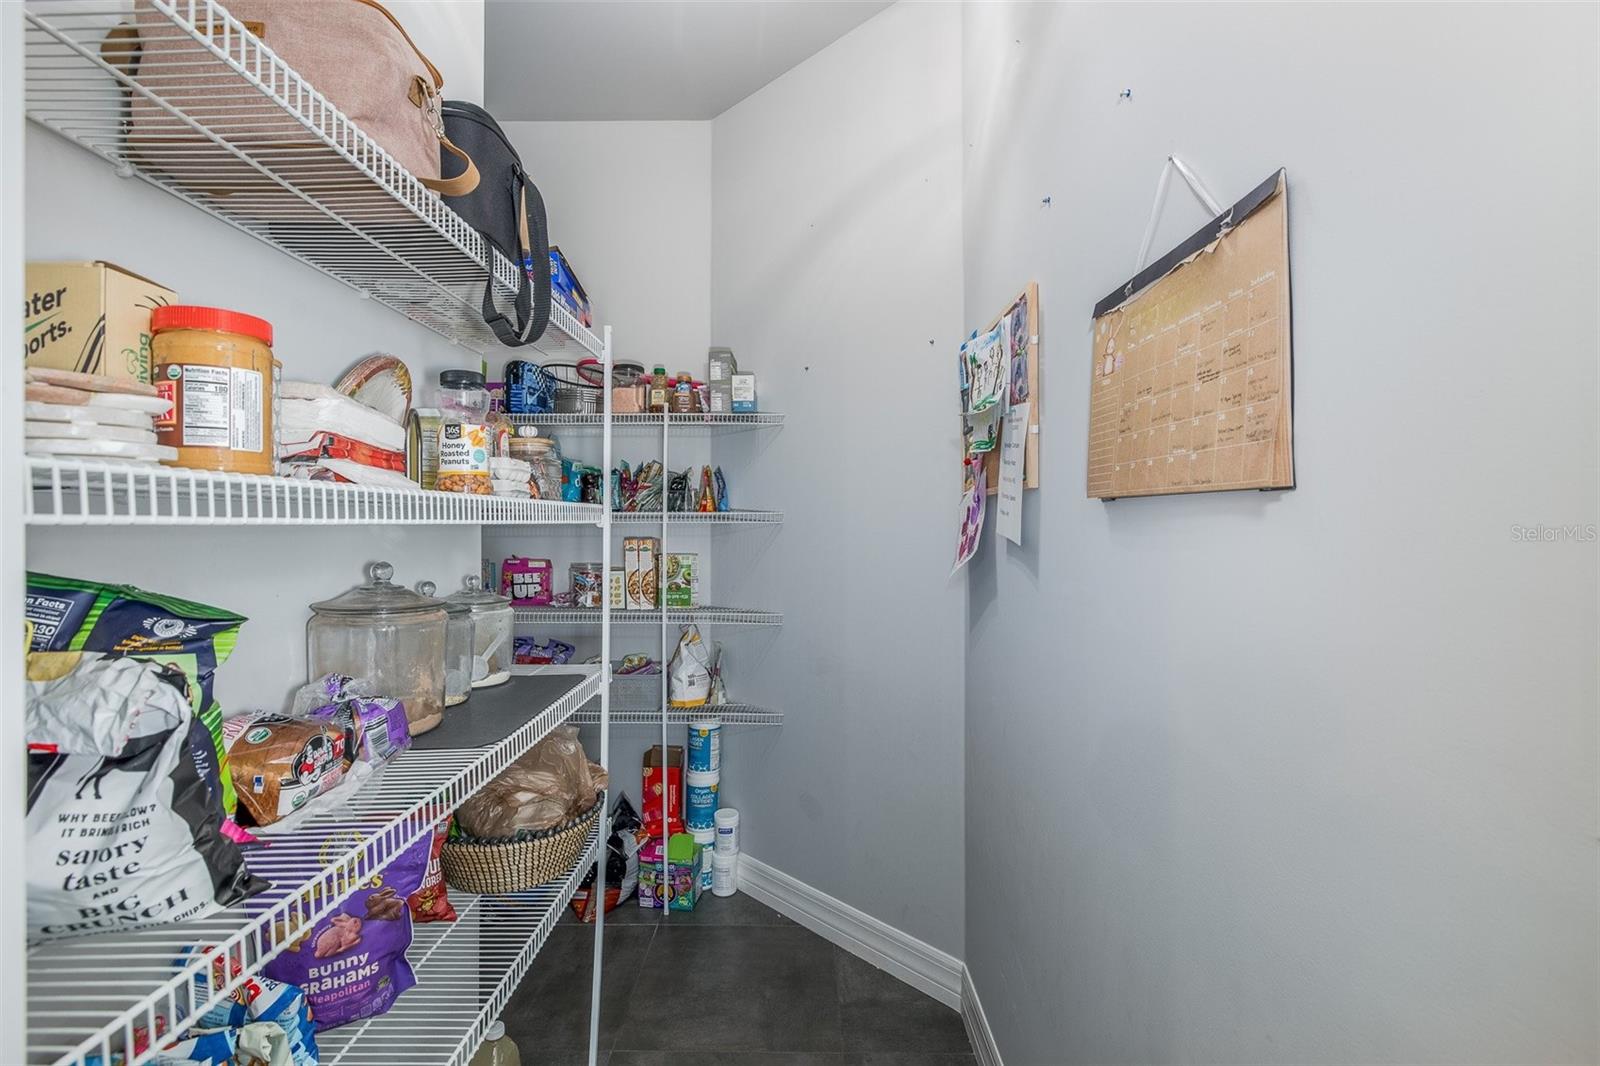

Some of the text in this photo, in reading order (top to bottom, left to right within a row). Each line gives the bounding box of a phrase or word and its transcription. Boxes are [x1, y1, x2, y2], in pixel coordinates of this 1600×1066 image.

[446, 426, 461, 434] 365
[441, 442, 466, 450] Honey
[34, 598, 66, 609] Facts
[33, 624, 56, 636] 130
[58, 813, 88, 823] WHY
[61, 828, 75, 838] IT
[121, 818, 150, 832] RICH
[62, 861, 141, 892] taste
[93, 887, 119, 899] AND
[40, 887, 190, 935] CRUNCH
[77, 894, 141, 919] BIG
